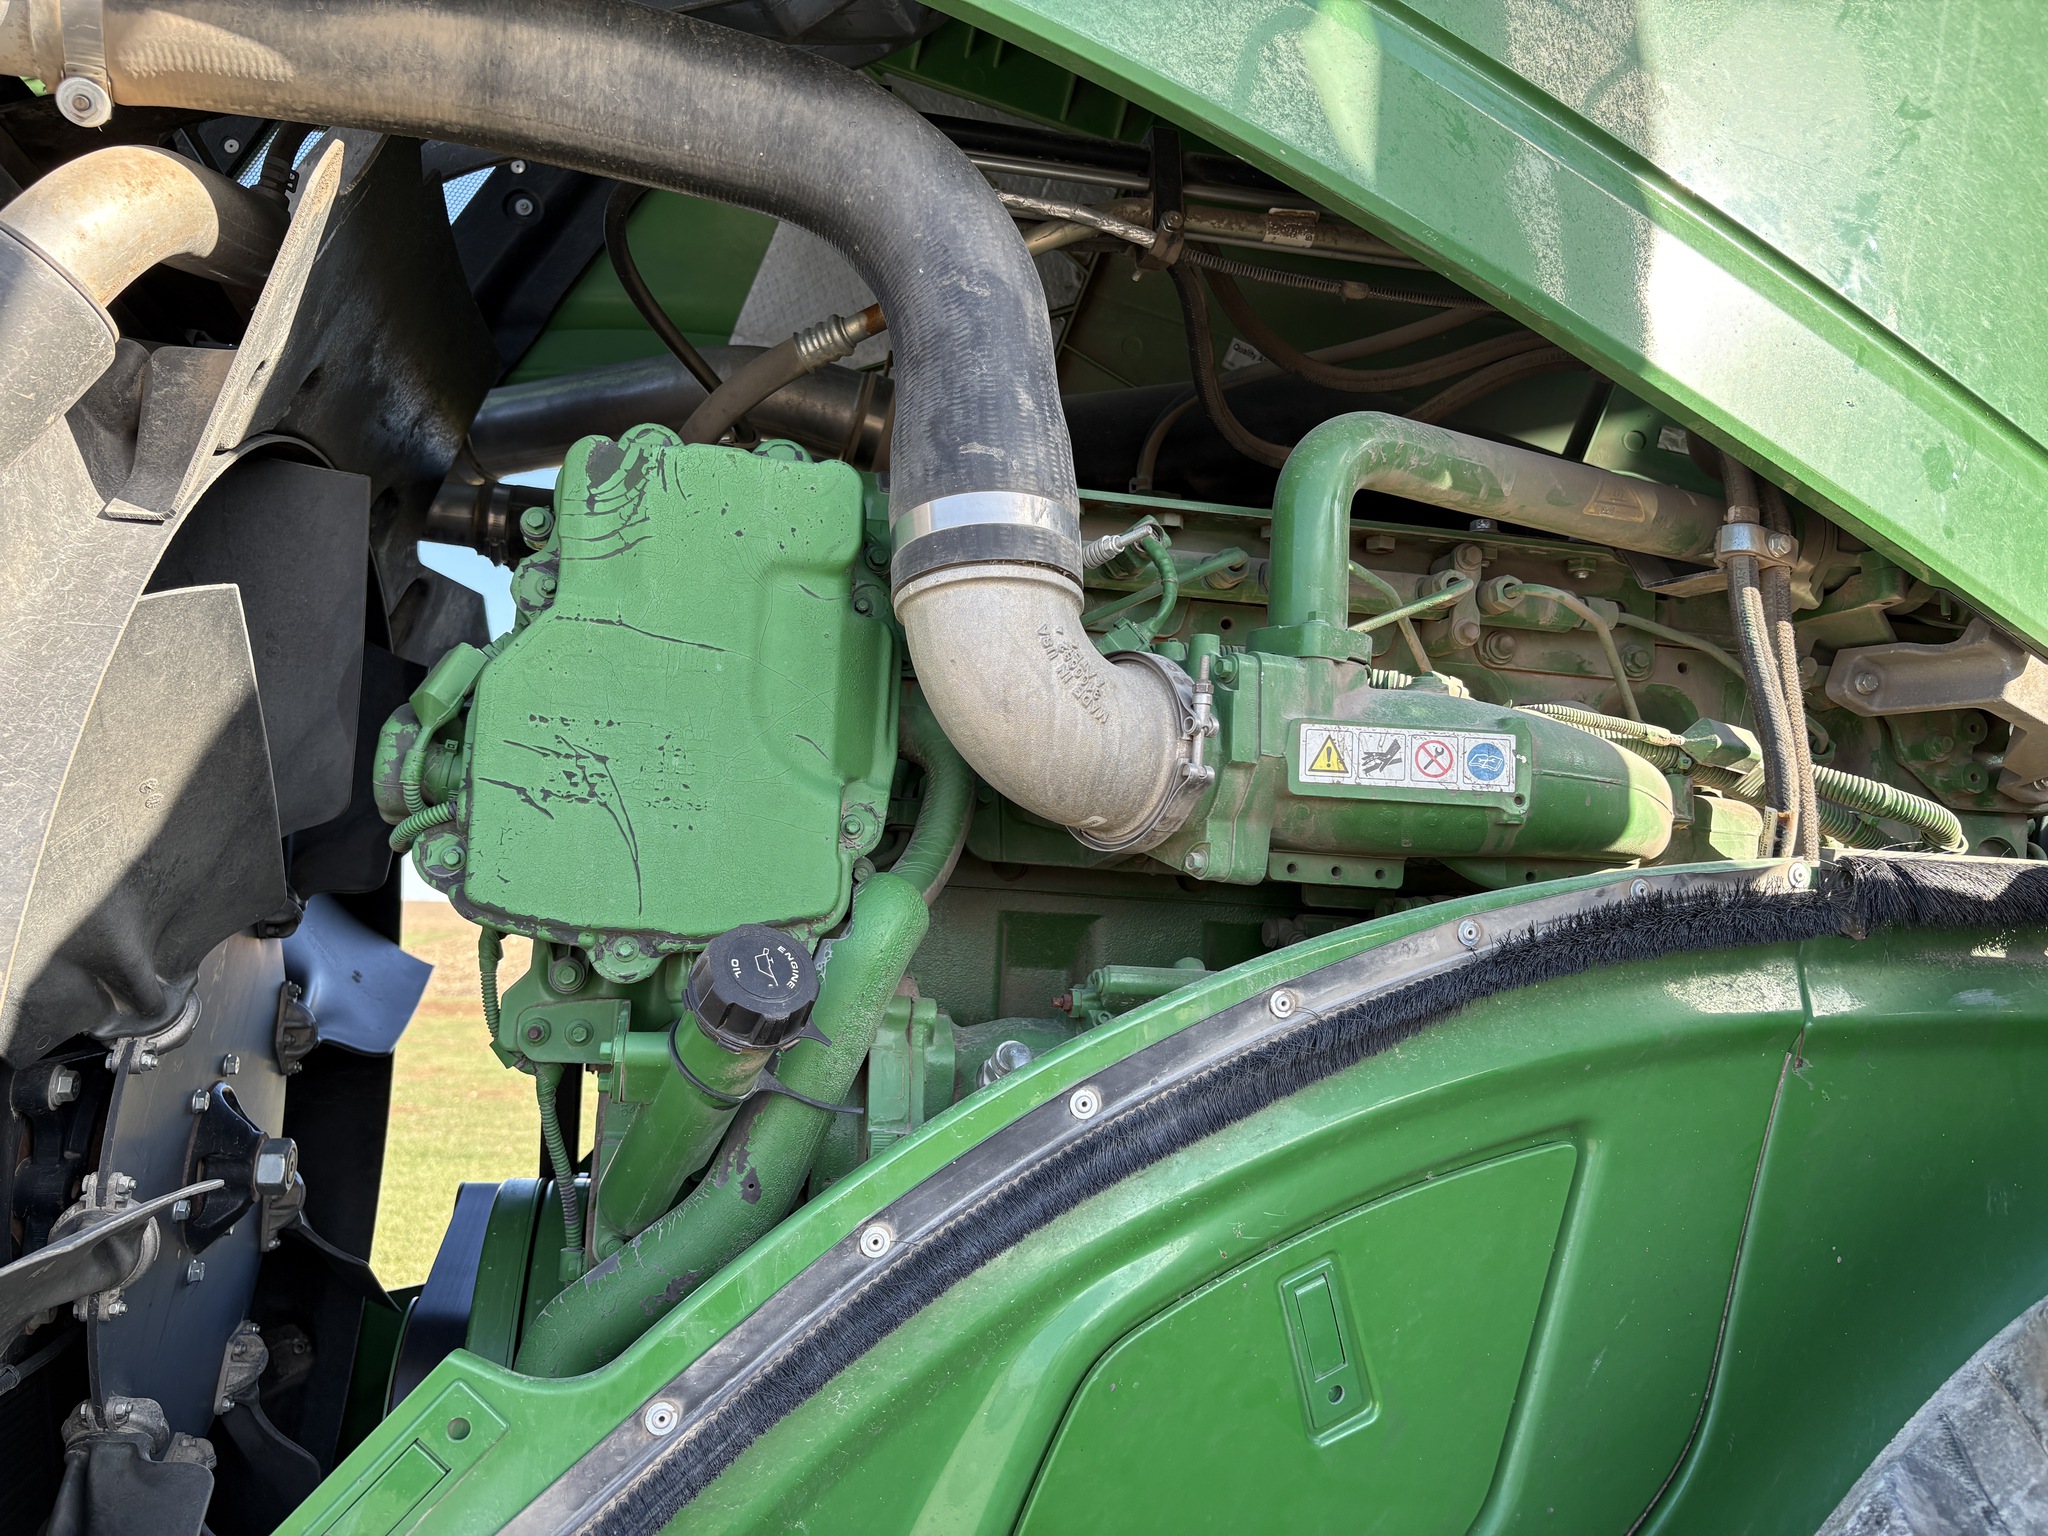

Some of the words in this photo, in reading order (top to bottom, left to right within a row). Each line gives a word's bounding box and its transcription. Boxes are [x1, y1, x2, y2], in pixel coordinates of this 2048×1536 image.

[1232, 342, 1257, 360] Quality
[1735, 560, 1747, 586] USA
[1036, 623, 1058, 661] USA
[1055, 663, 1073, 685] IN
[1071, 683, 1109, 724] MADE
[731, 959, 742, 978] OIL
[777, 946, 800, 989] ENGINE
